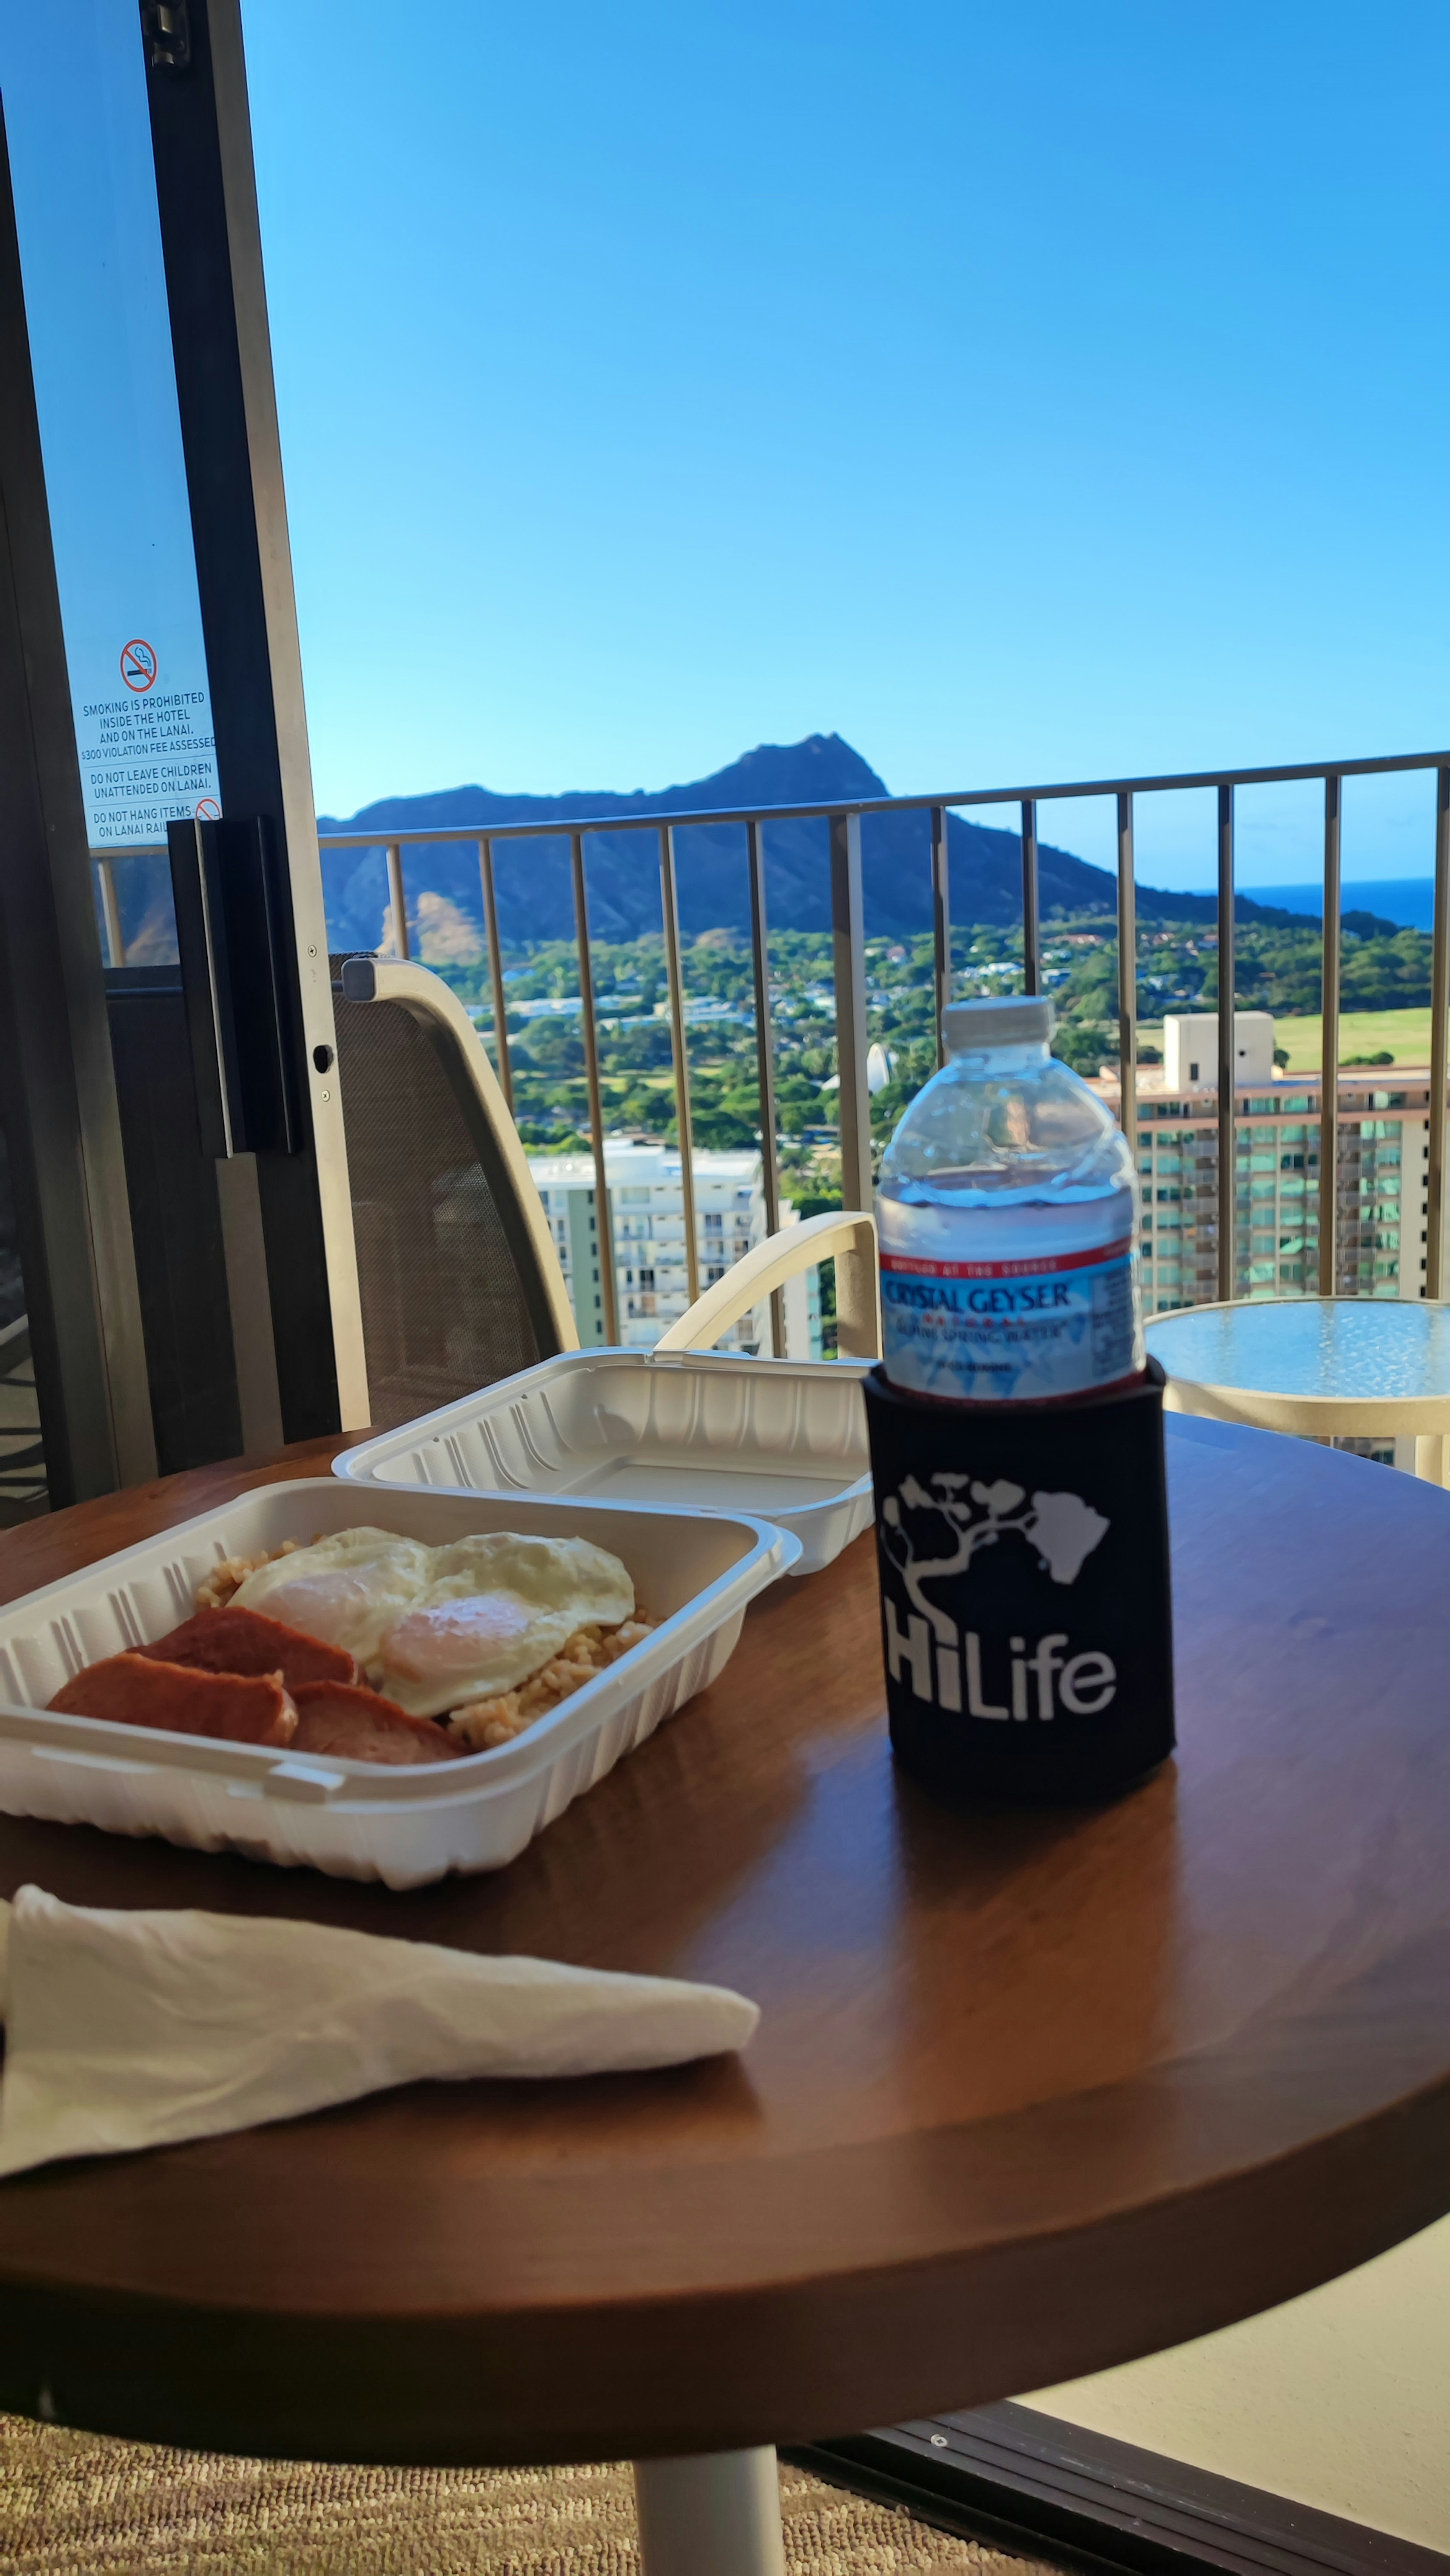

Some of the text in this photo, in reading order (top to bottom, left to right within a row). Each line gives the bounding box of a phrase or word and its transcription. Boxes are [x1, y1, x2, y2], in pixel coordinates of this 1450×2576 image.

[83, 692, 204, 716] SMOKING IS PROHIBITED
[100, 709, 190, 729] INSIDE THE HOTEL
[100, 724, 194, 744] AND ON THE LANAI.
[82, 737, 215, 761] $300 VIOLATION FEE ASSESSED
[91, 762, 211, 784] DO NOT LEAVE CHILDREN
[94, 778, 211, 798] UNATTENDED ON LANAI.
[94, 806, 191, 824] DO NOT HANG ITEMS
[99, 827, 112, 837] ON
[115, 824, 143, 836] LANAI
[885, 1280, 1070, 1313] CRYSTAL GEYSER
[884, 1595, 1117, 1721] HiLife
